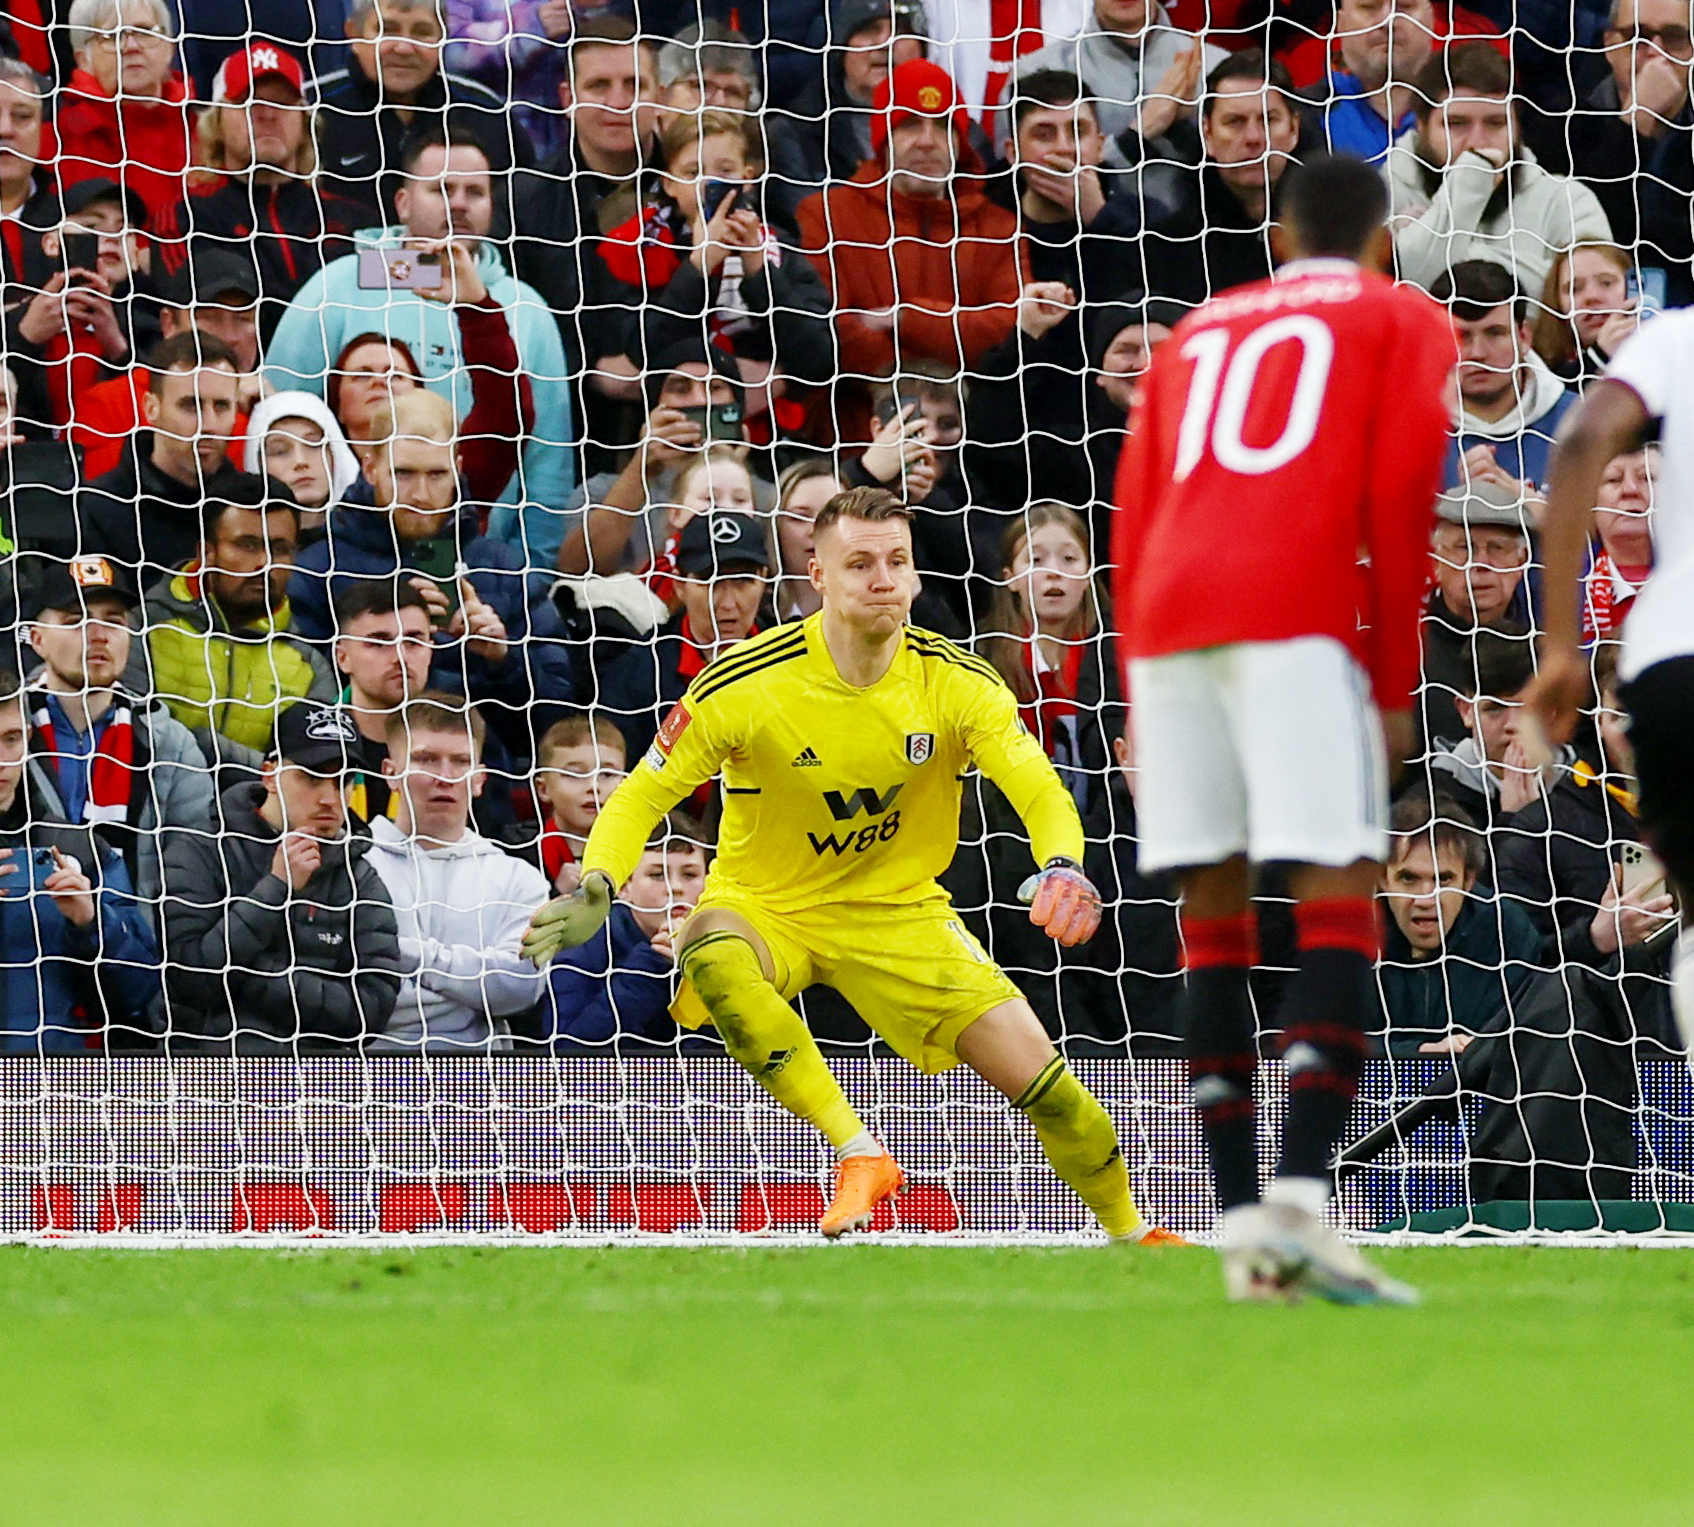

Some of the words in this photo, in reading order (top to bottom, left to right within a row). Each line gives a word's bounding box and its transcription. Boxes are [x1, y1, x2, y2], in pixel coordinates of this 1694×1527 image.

[1173, 314, 1335, 482] 10
[791, 758, 822, 767] adidas
[807, 810, 901, 856] W88
